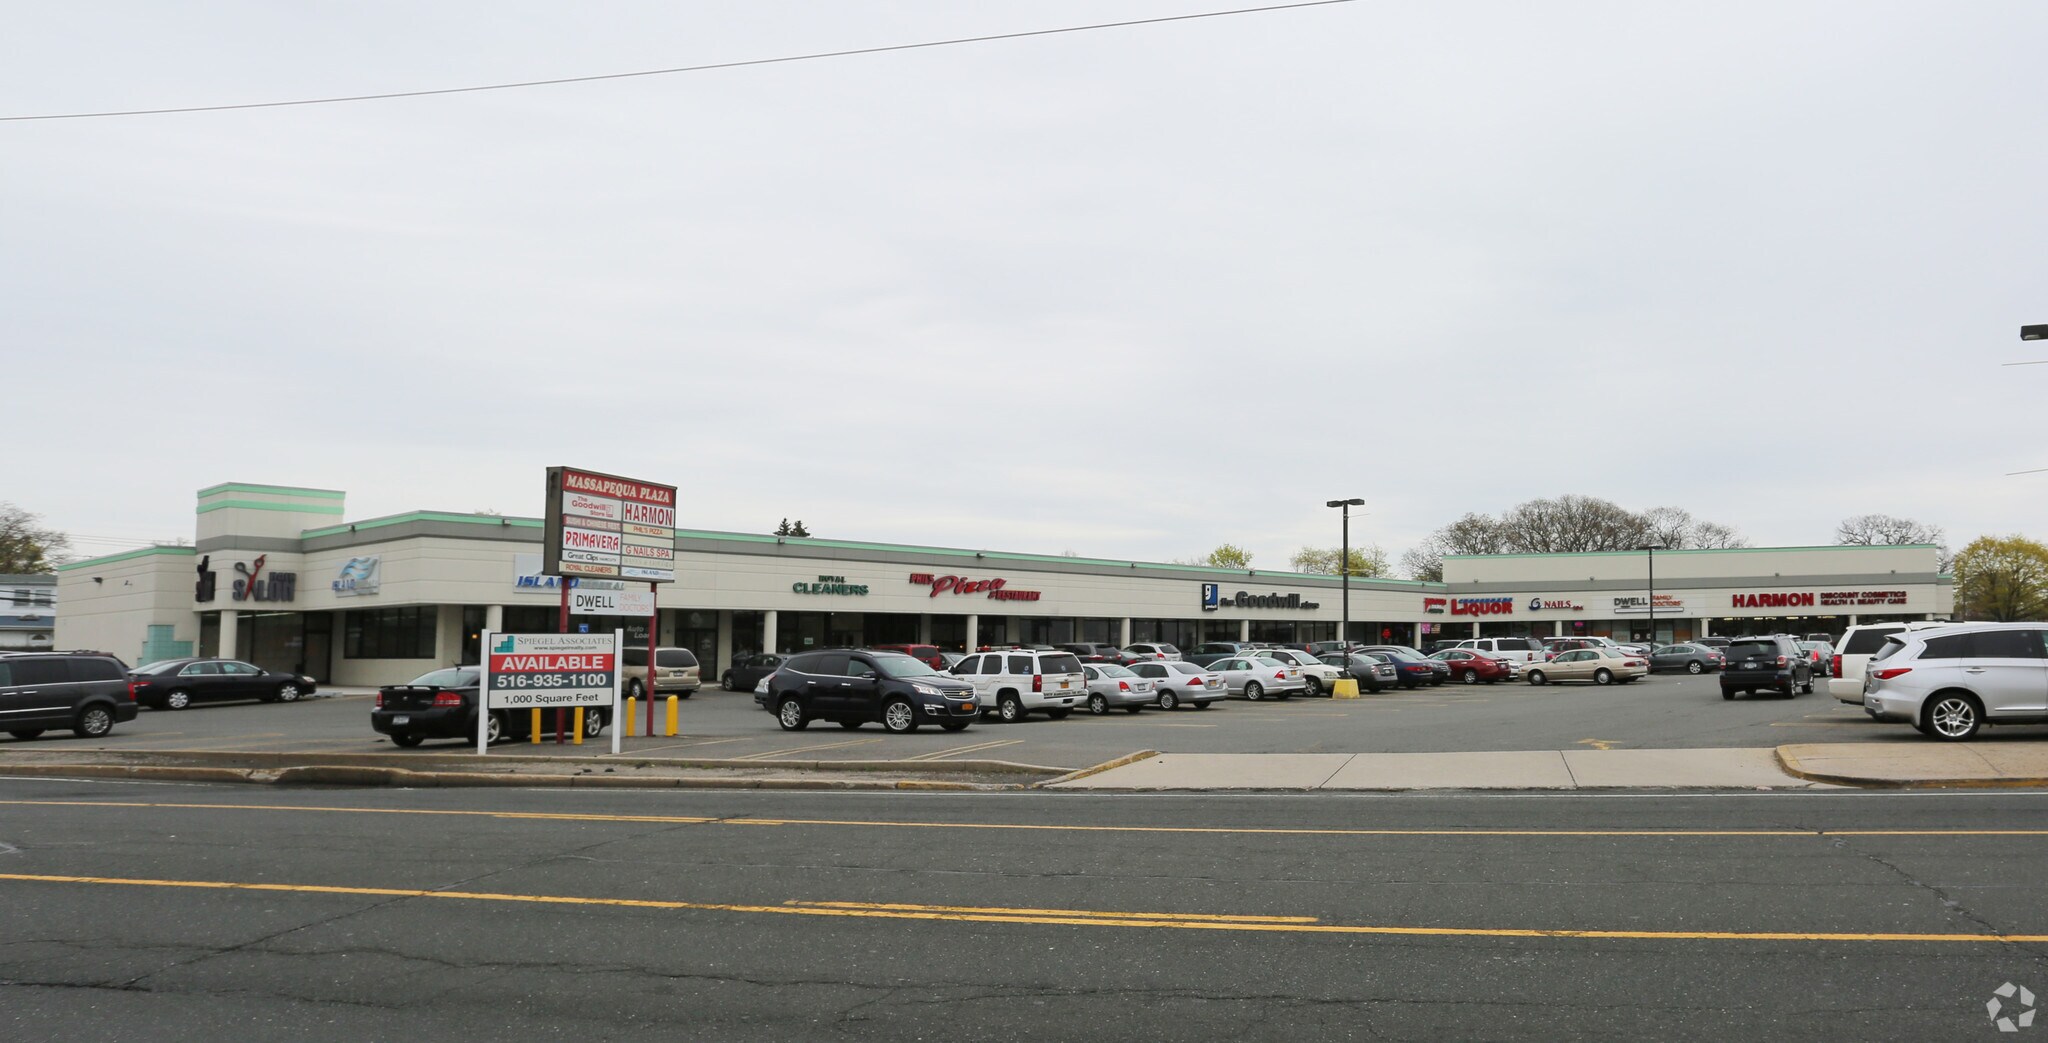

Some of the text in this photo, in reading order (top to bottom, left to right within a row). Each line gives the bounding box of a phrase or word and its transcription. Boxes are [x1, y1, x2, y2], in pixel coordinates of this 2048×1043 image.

[566, 474, 670, 503] MASSAPEQUA PLAZA
[571, 500, 606, 510] Goodwill
[625, 503, 673, 526] HARMON
[565, 531, 619, 551] PRIMAVERA
[567, 552, 584, 560] Great
[586, 553, 599, 563] Clips
[626, 546, 670, 558] G NAILS SPA
[565, 563, 613, 573] ROYAL CLEANERS
[793, 582, 869, 596] CLEANERS
[930, 575, 1007, 597] Pizza
[576, 594, 614, 608] DWELL
[1235, 590, 1300, 608] Goodwill
[1544, 600, 1571, 609] NAILS
[1614, 597, 1648, 606] DWELL
[1732, 592, 1815, 608] HARMON
[619, 603, 650, 612] DOCTORS
[1450, 598, 1513, 617] LIQUOR
[518, 636, 612, 645] SPIEGEL ASSOCIATES
[501, 656, 604, 671] AVAILABLE
[497, 673, 606, 688] 516-935-1100
[504, 693, 599, 704] 1,000 Square Feet
